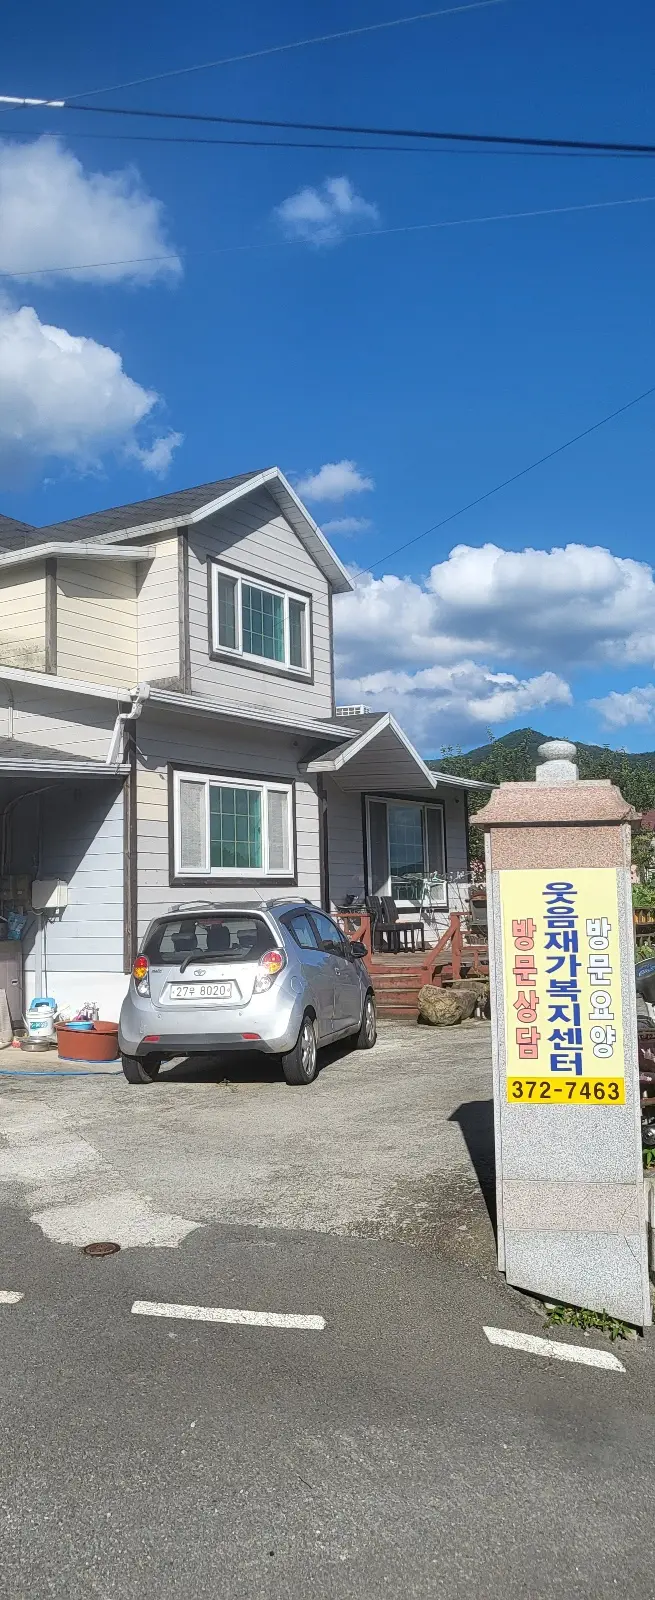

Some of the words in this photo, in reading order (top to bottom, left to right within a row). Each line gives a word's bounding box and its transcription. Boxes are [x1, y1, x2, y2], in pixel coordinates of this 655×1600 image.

[200, 985, 226, 996] 8020
[512, 917, 541, 1060] 방문상담
[542, 881, 584, 1076] 웃음재가복지센터
[586, 917, 616, 1059] 방문요양
[511, 1080, 620, 1101] 372-7463
